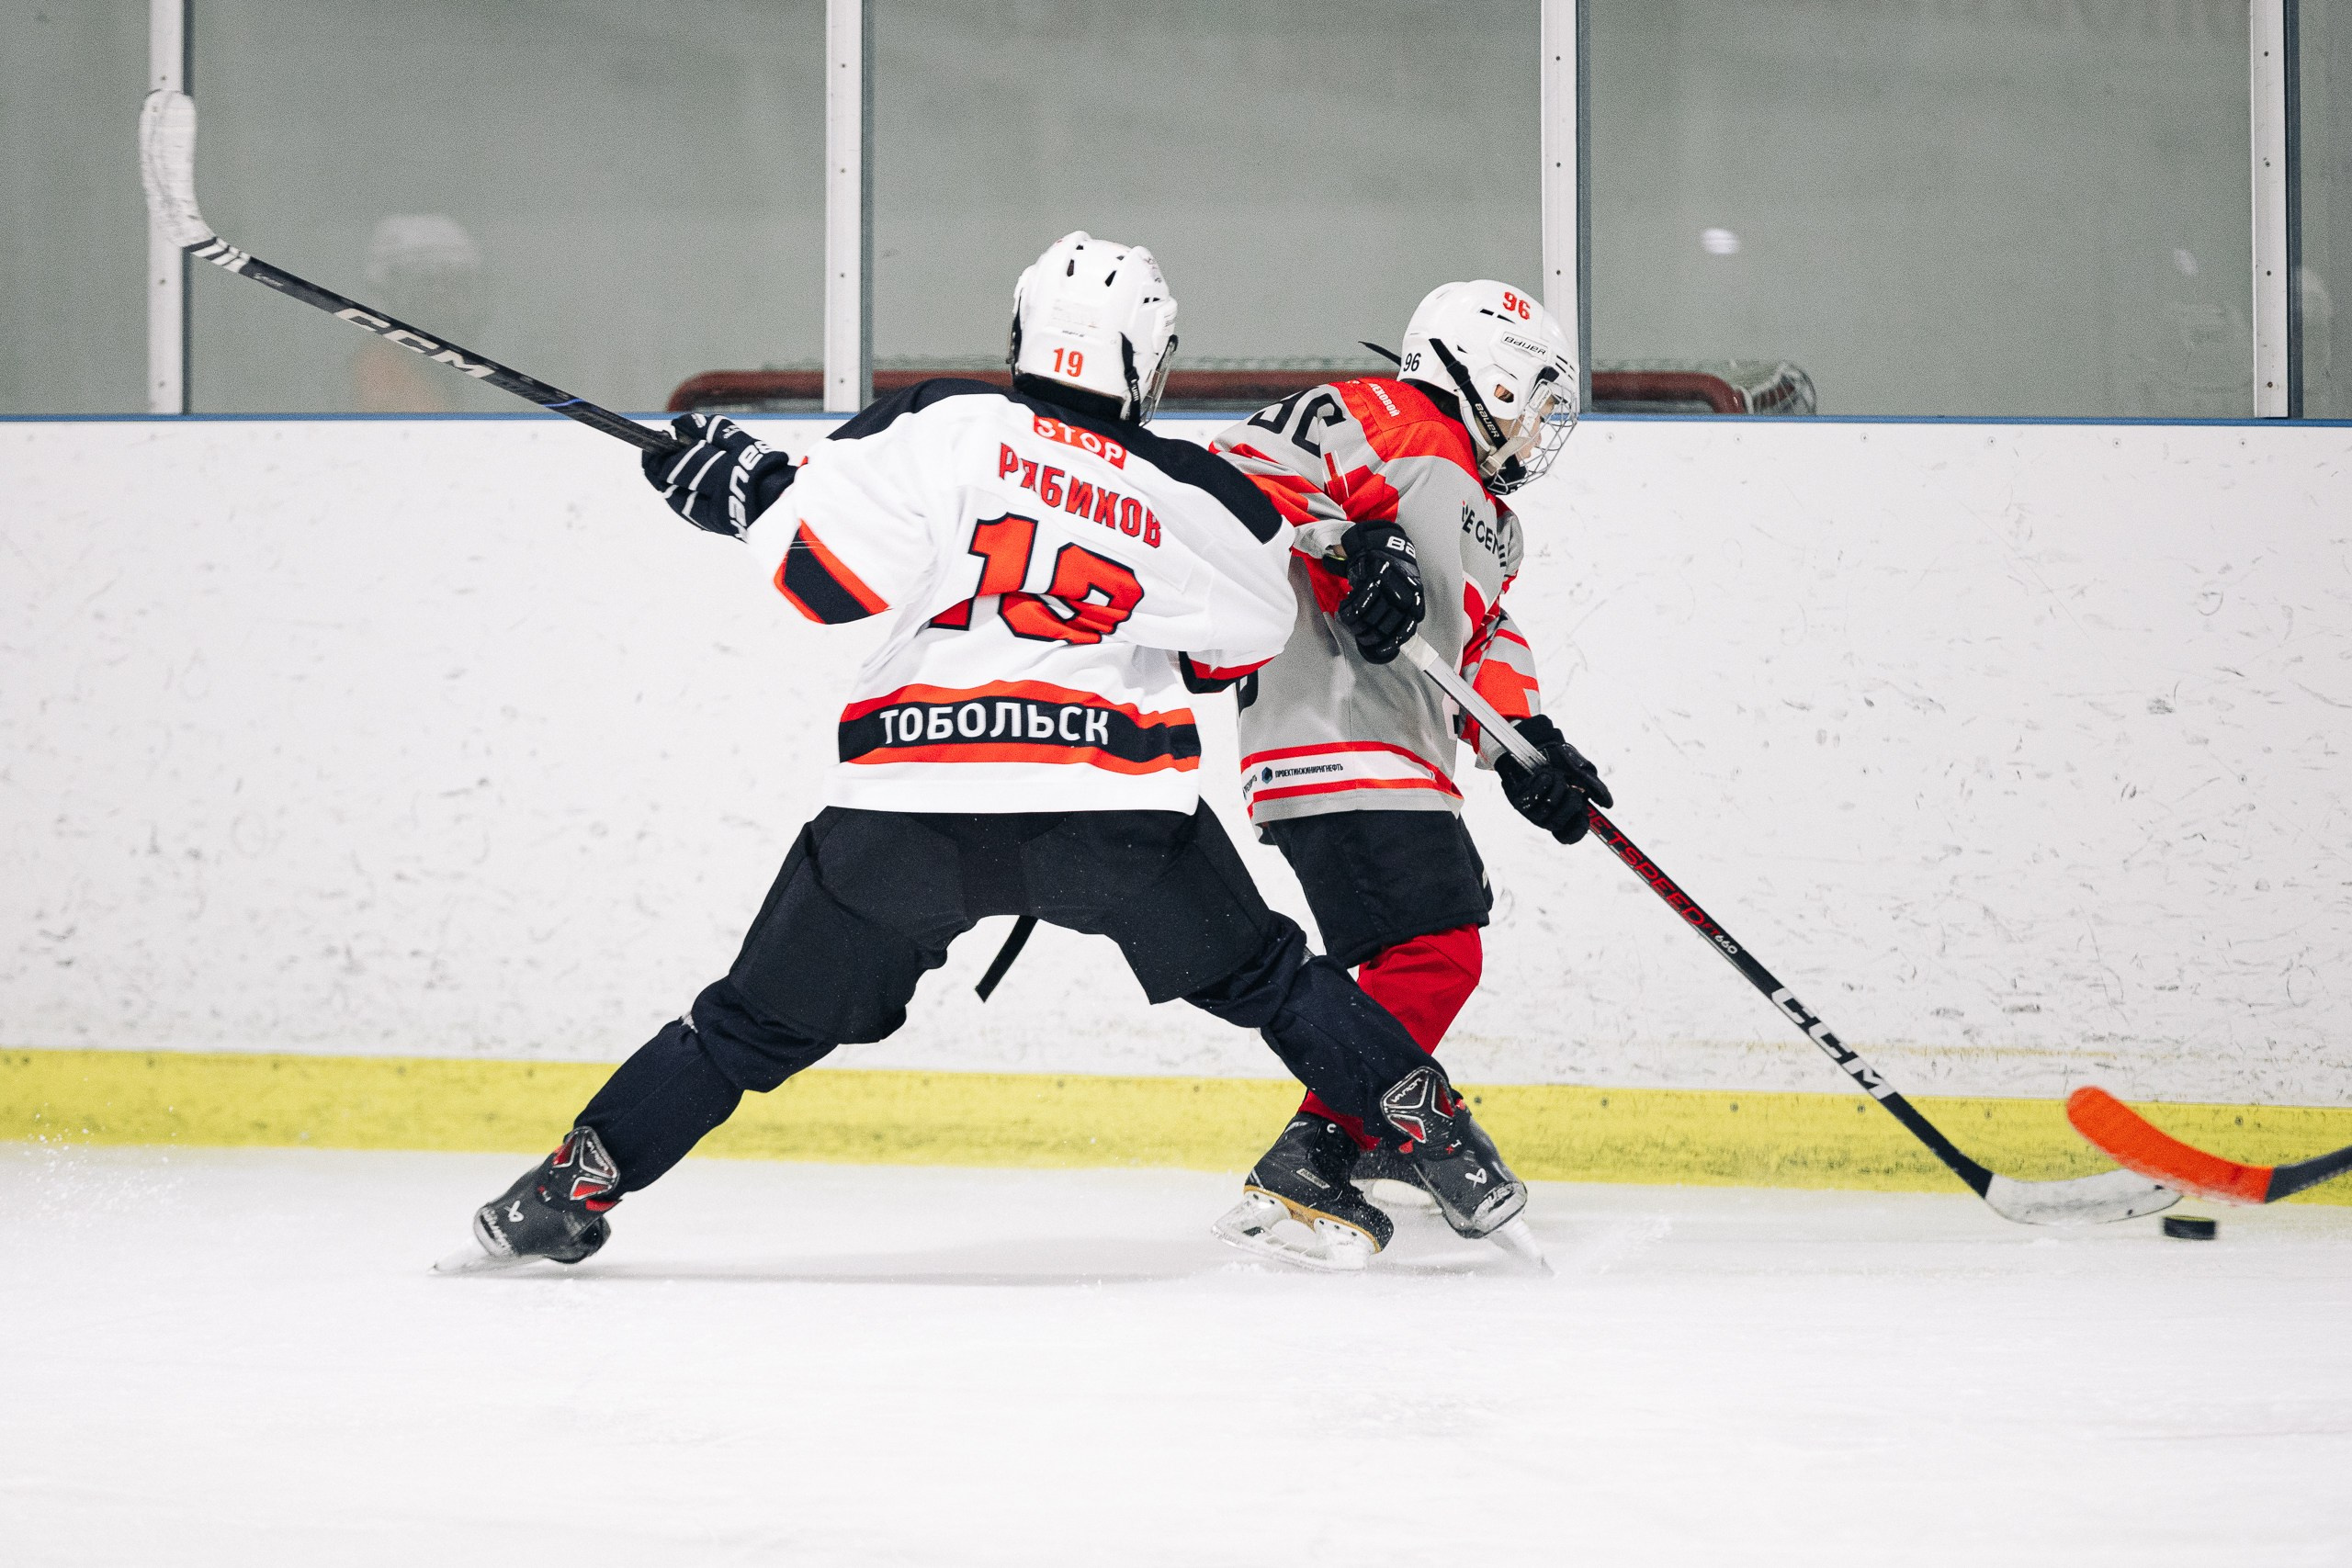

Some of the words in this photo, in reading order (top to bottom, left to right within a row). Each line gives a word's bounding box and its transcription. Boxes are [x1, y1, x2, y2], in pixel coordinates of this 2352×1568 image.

[1503, 291, 1531, 321] 96
[334, 307, 496, 378] CCM
[1053, 347, 1084, 378] 19
[1403, 352, 1422, 372] 96
[1036, 418, 1124, 461] STOP
[999, 442, 1162, 549] РЯБИКОВ
[1386, 536, 1416, 558] BA
[928, 512, 1145, 645] 19
[879, 701, 1110, 746] ТОБОЛЬСК
[1588, 805, 1705, 926] ETSPEED
[1770, 987, 1897, 1100] CCM
